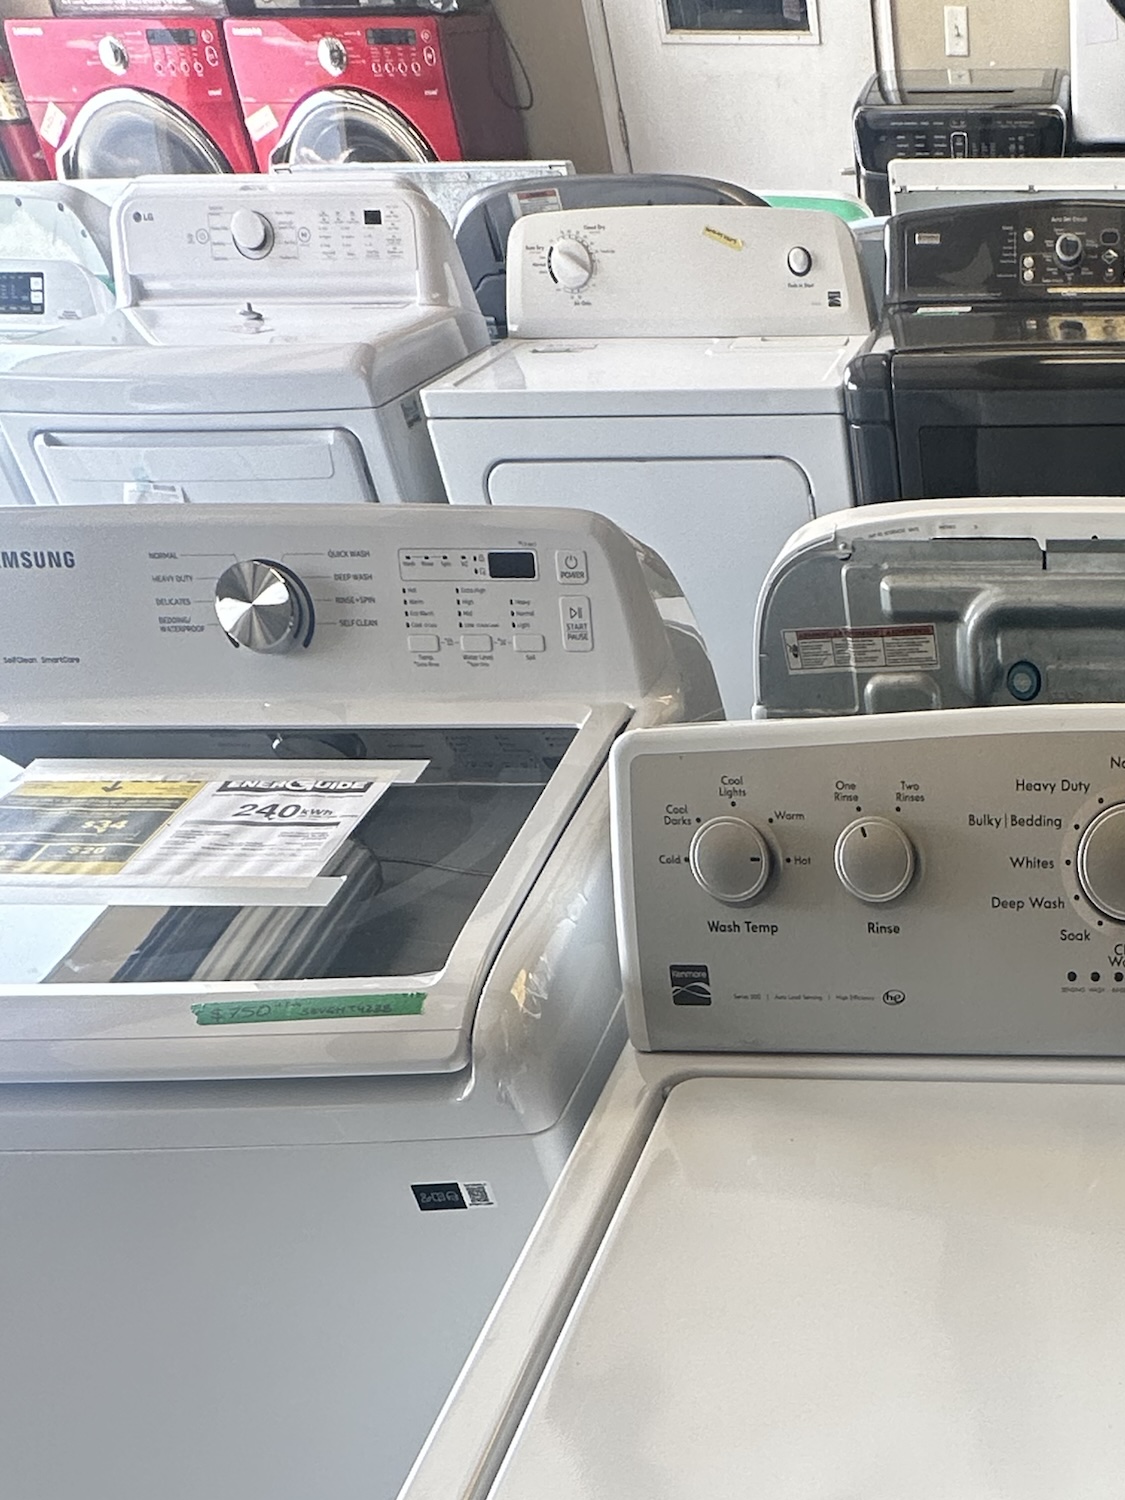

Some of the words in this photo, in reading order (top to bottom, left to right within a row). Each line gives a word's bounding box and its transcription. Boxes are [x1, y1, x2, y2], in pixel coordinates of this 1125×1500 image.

[143, 213, 154, 221] LG
[0, 550, 76, 569] MSUNG
[327, 550, 348, 558] QUICK
[350, 550, 371, 558] WASH
[333, 573, 350, 581] DEEP
[352, 573, 373, 581] WASH
[560, 571, 585, 579] POWER
[155, 598, 191, 606] DELICATES
[338, 619, 354, 627] SELF
[355, 619, 378, 627] CLEAN
[567, 623, 588, 631] START
[160, 625, 205, 633] WATERPROOF
[41, 656, 80, 664] SmartCare
[720, 775, 744, 786] Cool
[835, 780, 856, 791] One
[900, 780, 920, 791] Two
[1015, 779, 1056, 794] Heavy
[1061, 779, 1091, 794] Duty
[718, 787, 747, 799] Lights
[834, 791, 859, 802] Rinse
[895, 792, 925, 802] Rinses
[231, 803, 302, 820] 240
[301, 808, 333, 816] kWh
[665, 804, 689, 815] Cool
[663, 815, 692, 826] Darks
[774, 811, 805, 820] Warm
[81, 819, 129, 833] $34
[968, 814, 1002, 829] Bulky
[1011, 814, 1062, 830] Bedding
[67, 846, 107, 855] $20
[658, 854, 681, 865] Cold
[794, 857, 811, 866] Hot
[1009, 856, 1055, 869] Whites
[991, 897, 1025, 911] Deep
[1029, 897, 1065, 909] Wash
[707, 920, 741, 933] Wash
[744, 921, 779, 935] Temp
[867, 922, 900, 934] Rinse
[1060, 929, 1091, 942] Soak
[672, 970, 708, 979] Kenmore
[211, 1003, 272, 1023] $750
